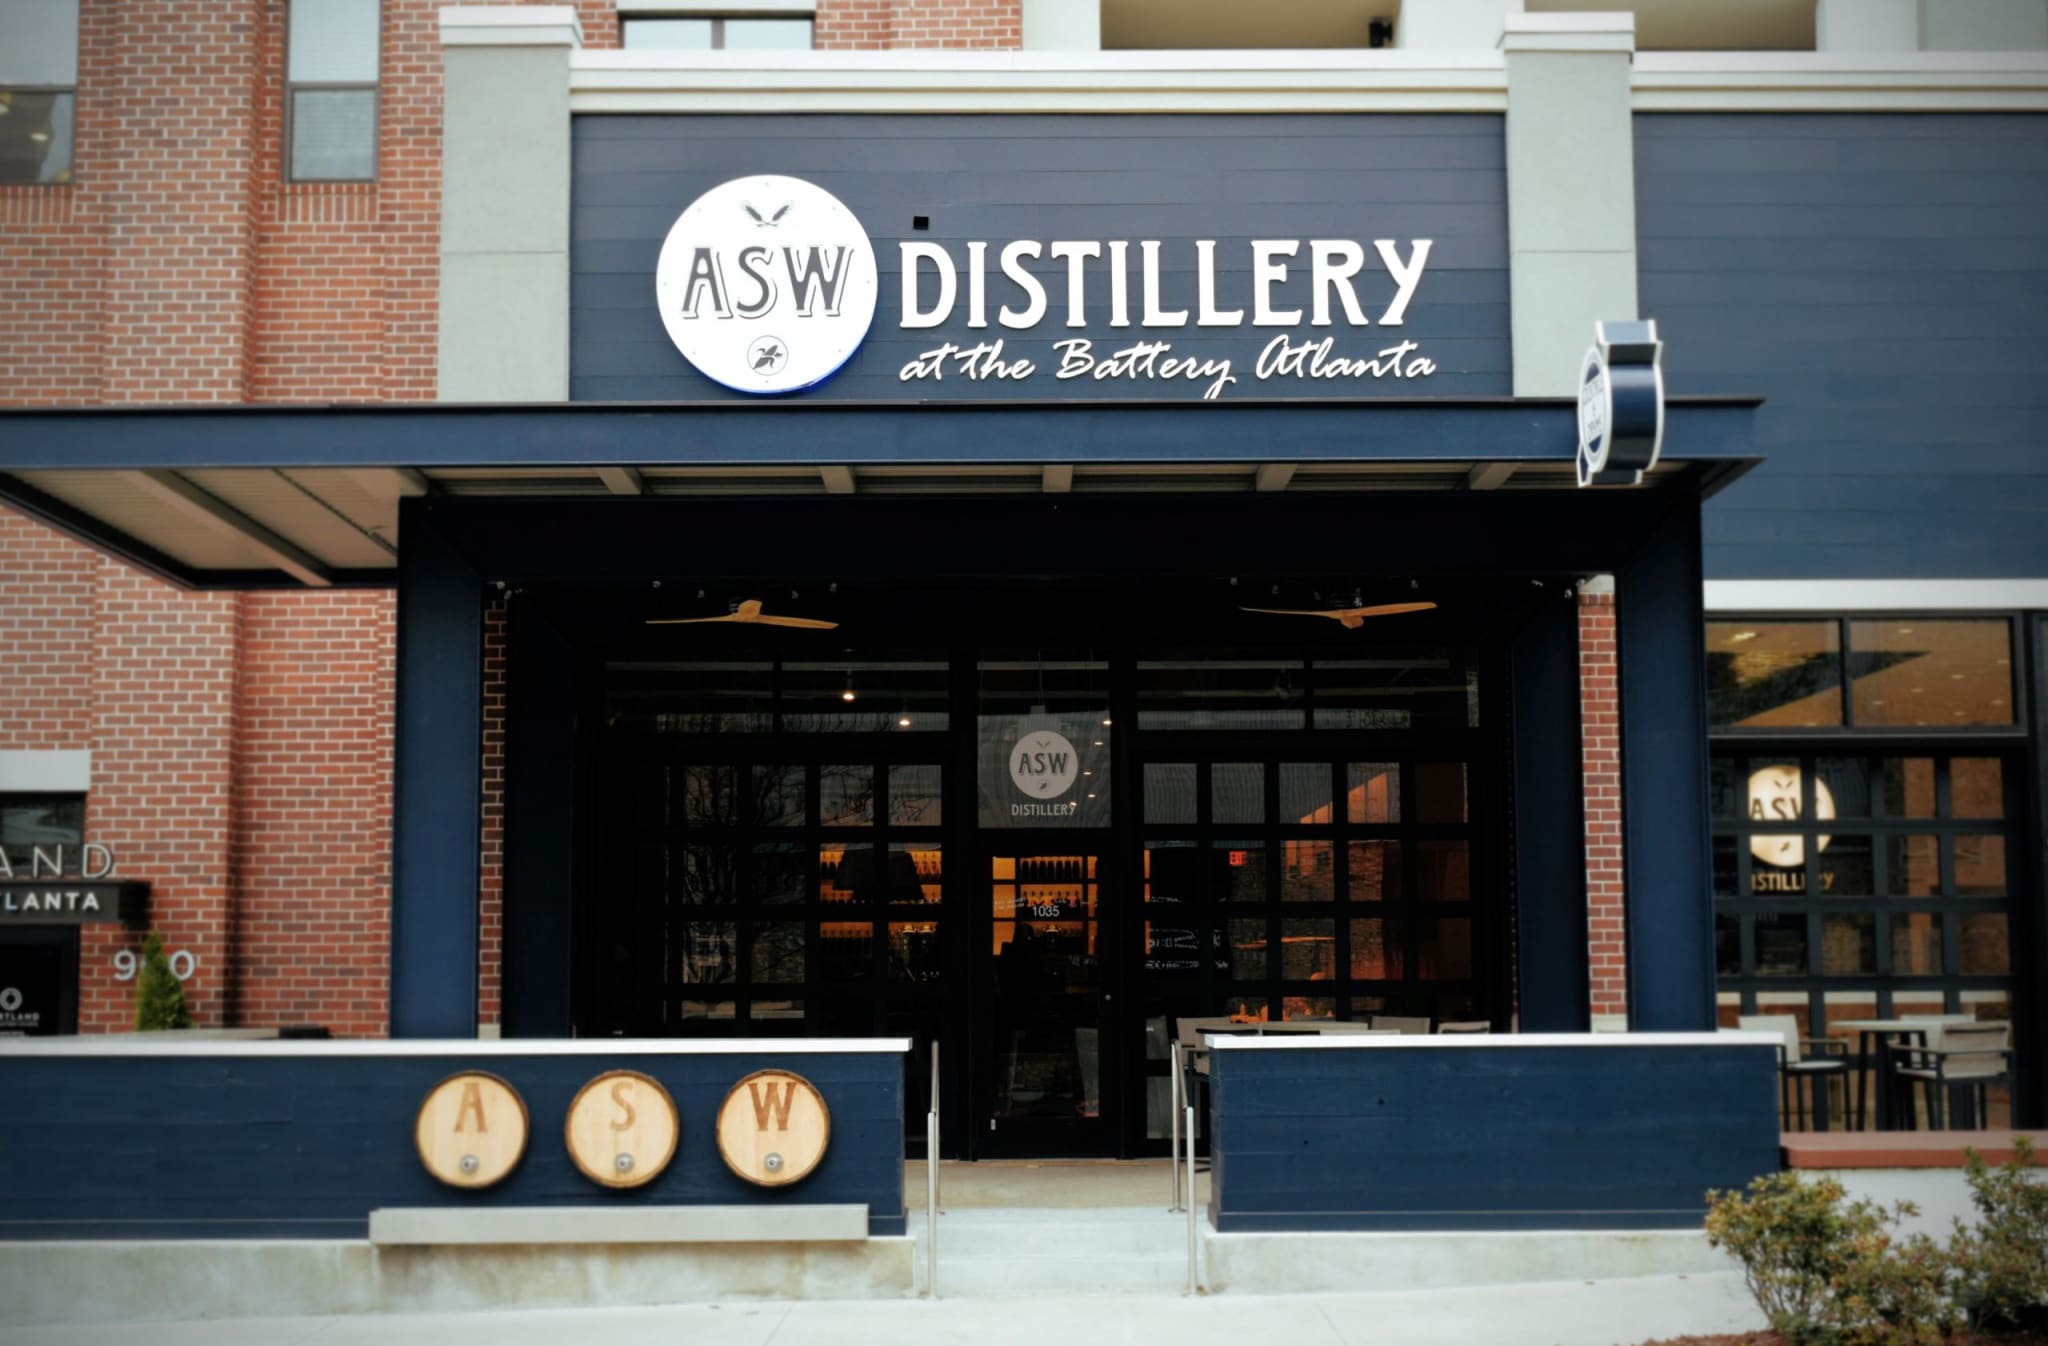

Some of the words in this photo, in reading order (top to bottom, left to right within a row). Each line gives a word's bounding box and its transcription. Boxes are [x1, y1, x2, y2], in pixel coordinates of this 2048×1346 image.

[682, 246, 853, 319] ASW
[899, 240, 1433, 329] DISTILLERY
[899, 342, 957, 380] at
[954, 338, 1035, 380] the
[1053, 339, 1236, 399] Battery
[1255, 334, 1436, 379] Atlanta
[1018, 752, 1067, 776] ASW
[1011, 803, 1076, 816] DISTILLERY
[1032, 905, 1060, 917] 1035
[114, 950, 195, 981] 90
[454, 1082, 488, 1133] A
[610, 1082, 636, 1132] S
[748, 1082, 797, 1131] W
